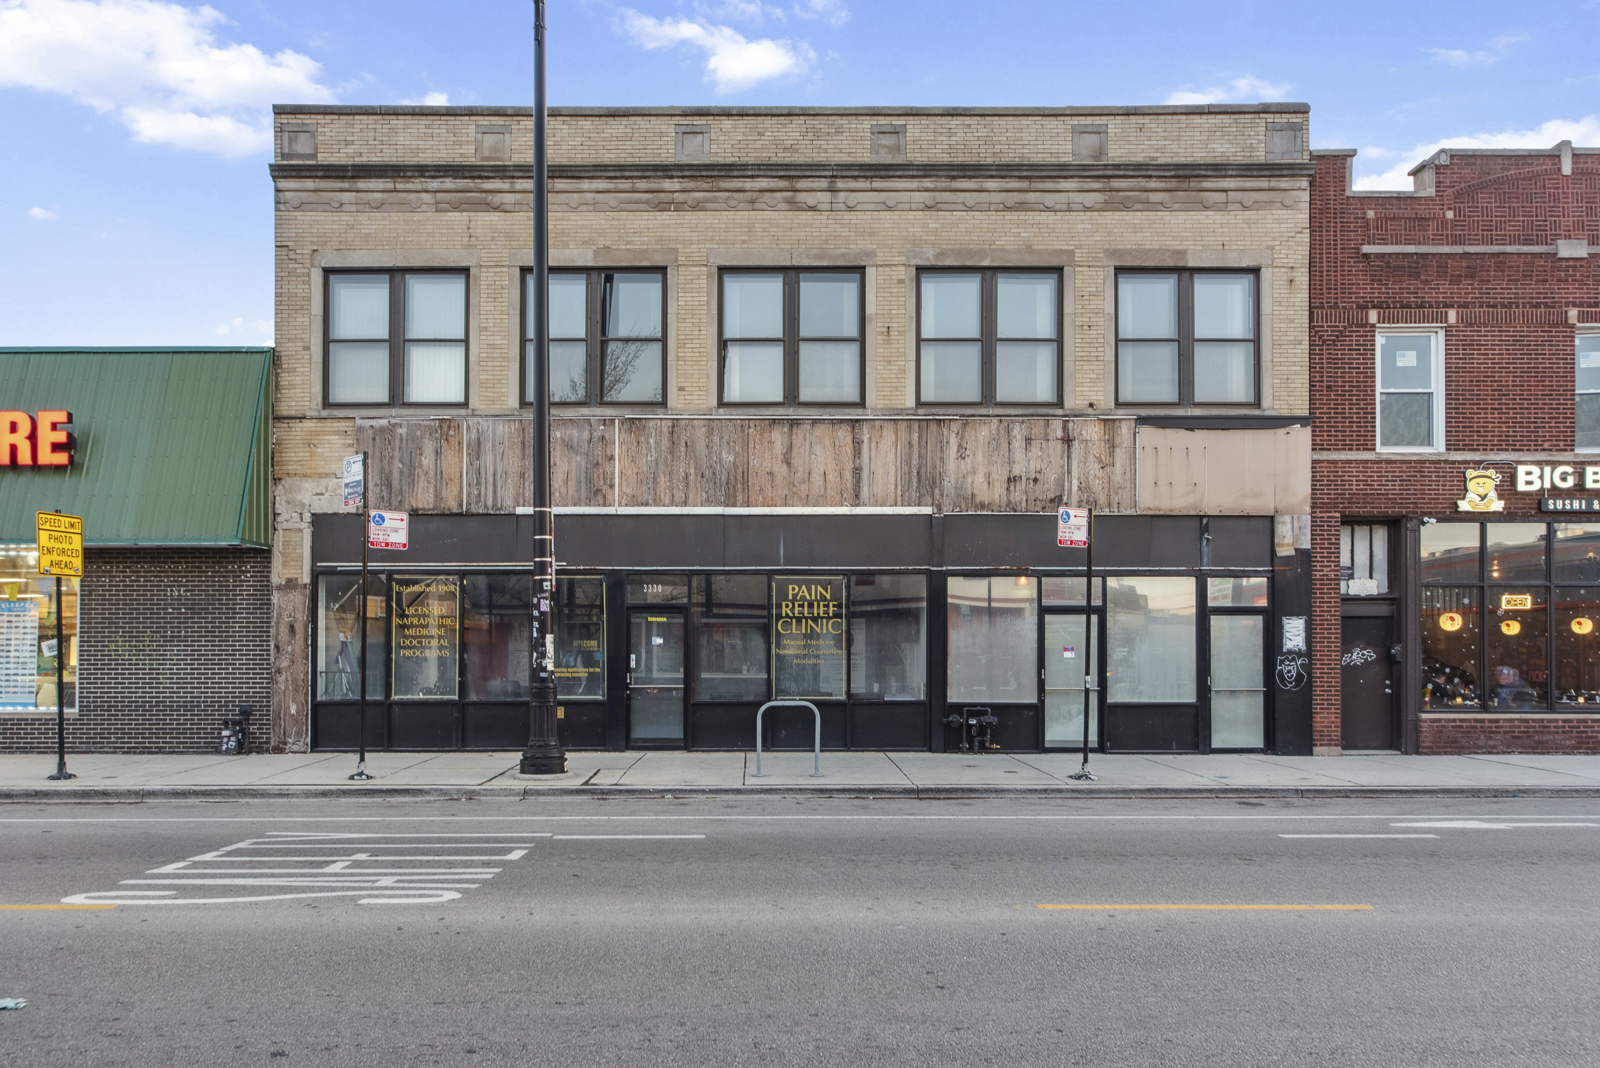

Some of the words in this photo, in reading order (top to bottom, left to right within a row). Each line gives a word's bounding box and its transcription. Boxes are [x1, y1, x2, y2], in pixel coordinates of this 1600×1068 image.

[1516, 465, 1575, 492] BIG
[1547, 499, 1586, 510] SUSHI
[40, 516, 62, 528] SPEED
[64, 520, 81, 531] LIMIT
[48, 533, 74, 545] PHOTO
[41, 546, 80, 558] ENFORCED
[49, 559, 74, 570] AHEAD
[643, 584, 662, 593] 3330
[788, 584, 831, 600] PAIN
[1505, 597, 1529, 607] OPEN
[405, 606, 445, 615] LICENSED
[781, 601, 838, 617] RELIEF
[395, 617, 455, 625] NAPRAPATHIC
[777, 618, 842, 634] CLINIC
[404, 628, 446, 636] MEDICINE
[400, 638, 450, 647] DOCTORAL
[400, 649, 450, 657] PROGRAMS
[809, 648, 843, 656] Counseling
